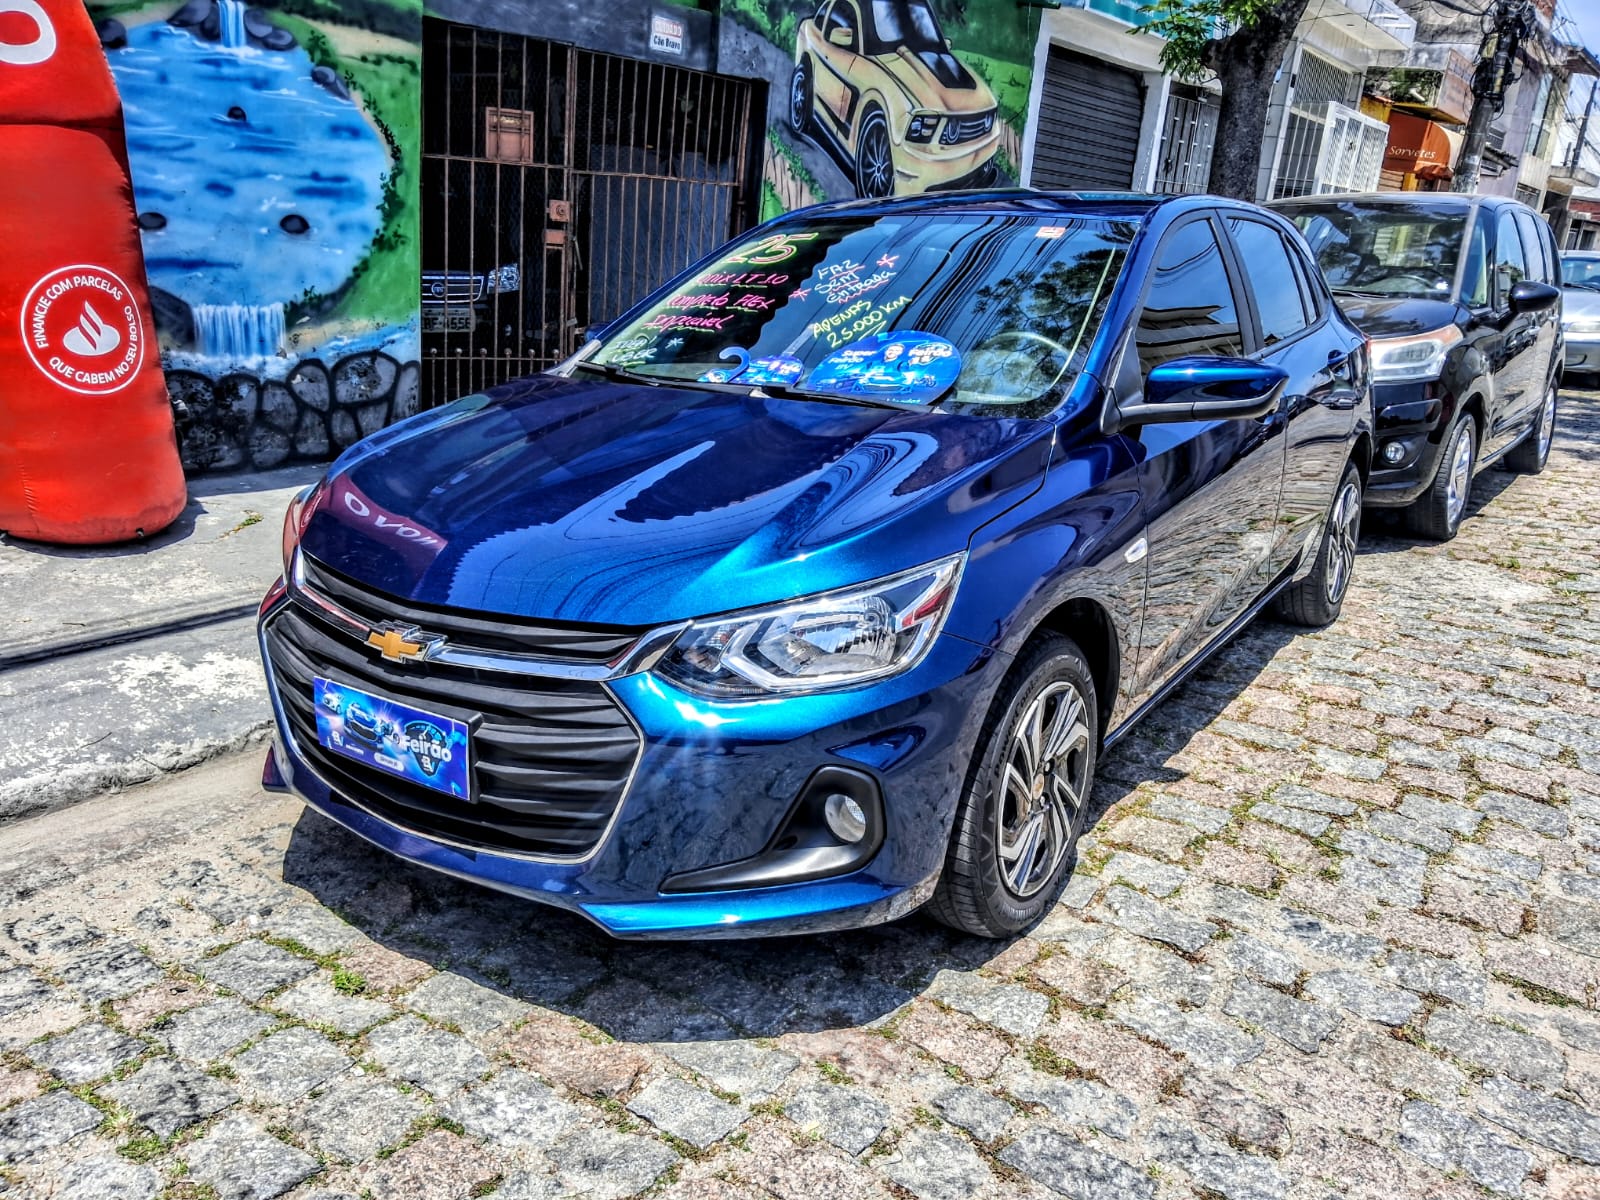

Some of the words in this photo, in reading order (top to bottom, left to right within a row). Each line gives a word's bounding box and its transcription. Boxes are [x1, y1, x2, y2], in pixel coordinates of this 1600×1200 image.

[665, 38, 681, 49] Bravo
[1388, 145, 1437, 159] Sorvetes
[722, 232, 819, 264] 25
[818, 259, 860, 280] FAZ
[33, 296, 51, 348] FINANCIE
[46, 278, 74, 300] COM
[73, 275, 123, 301] PARCELAS
[124, 305, 138, 342] BOLSO
[124, 342, 138, 365] SEU
[49, 356, 75, 378] QUE
[75, 371, 116, 384] CABEM
[114, 361, 129, 378] NO
[399, 733, 452, 762] Feirão
